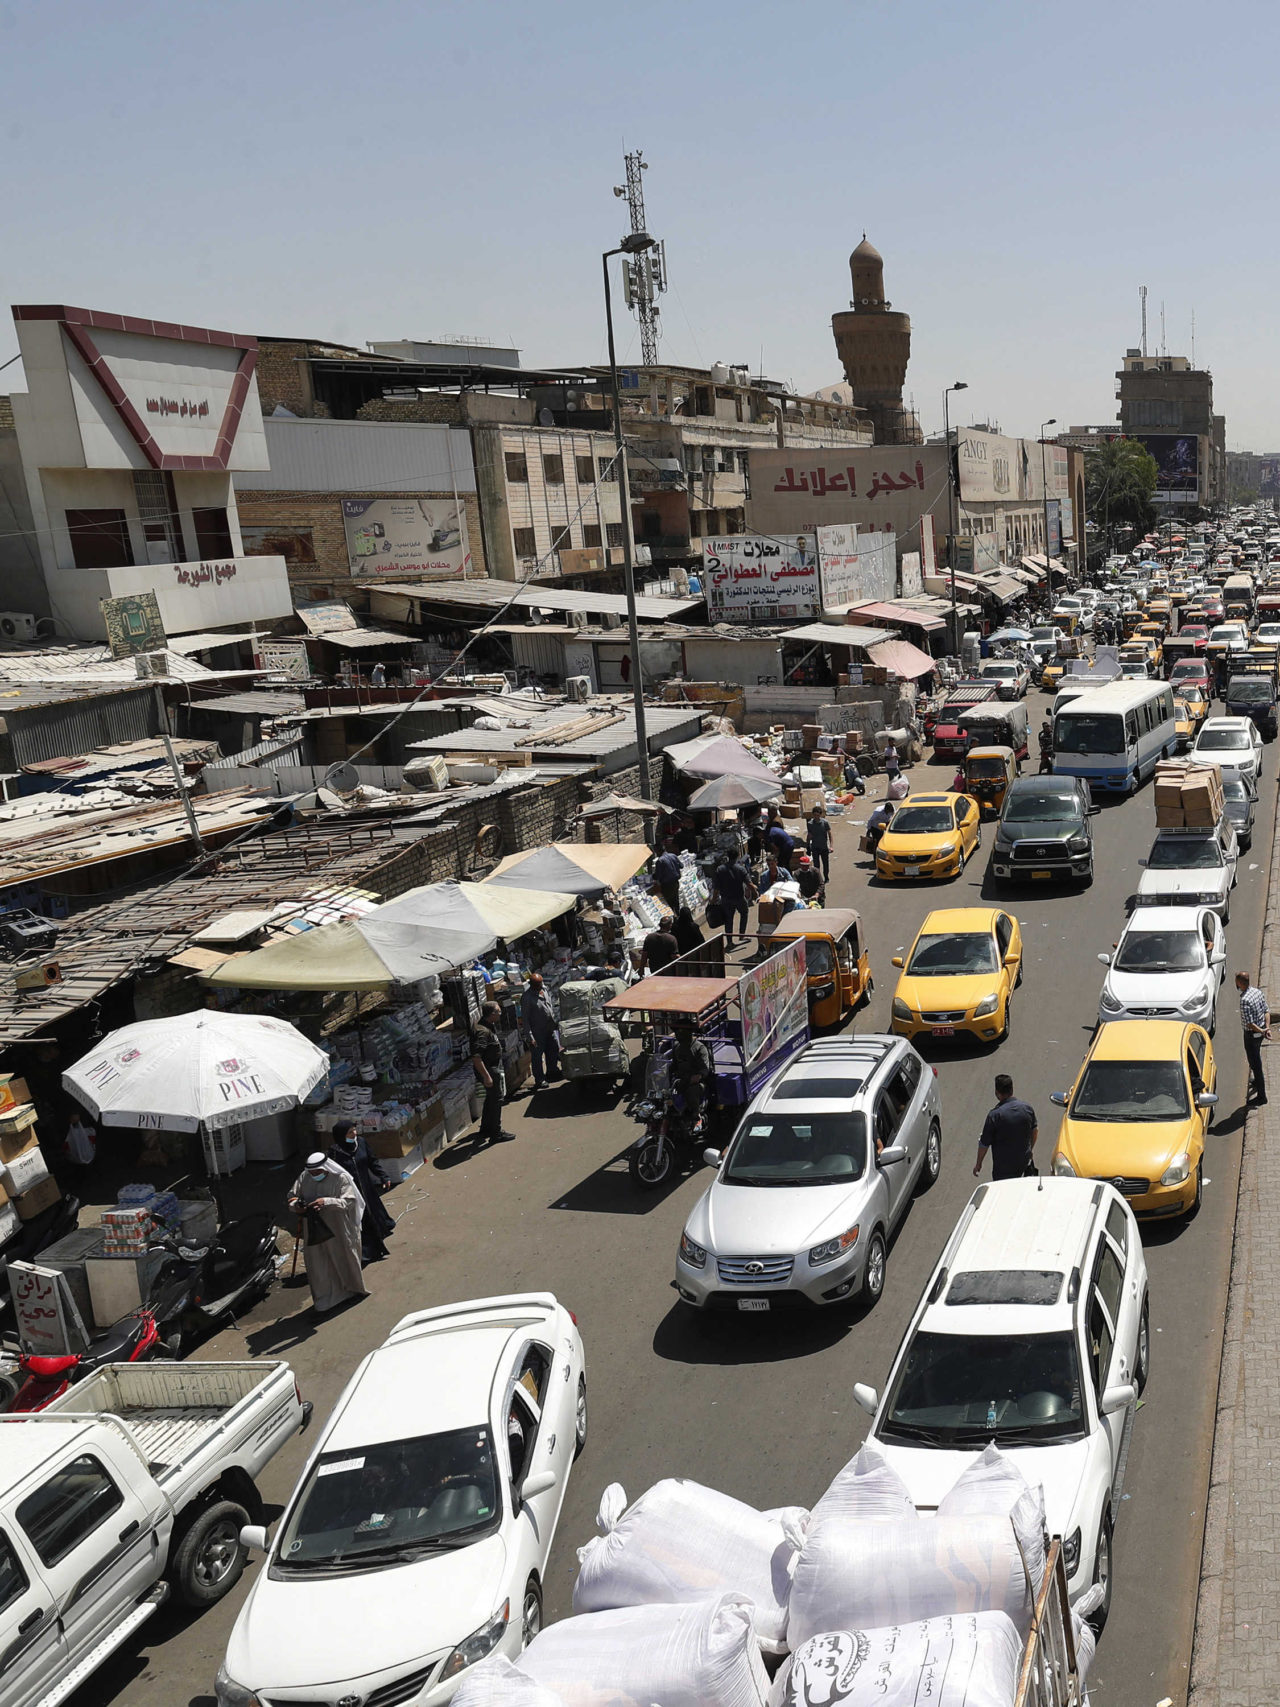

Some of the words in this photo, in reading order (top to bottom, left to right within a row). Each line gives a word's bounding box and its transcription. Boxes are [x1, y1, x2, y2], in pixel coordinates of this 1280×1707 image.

[774, 467, 857, 497] إعلانك
[865, 460, 925, 500] أحجز
[743, 541, 780, 558] محلات
[707, 557, 722, 573] 2
[770, 561, 815, 582] مصطفى
[85, 1060, 121, 1091] PINE
[217, 1074, 266, 1102] PINE
[138, 1114, 165, 1129] PINE
[17, 1273, 52, 1299] مرافق
